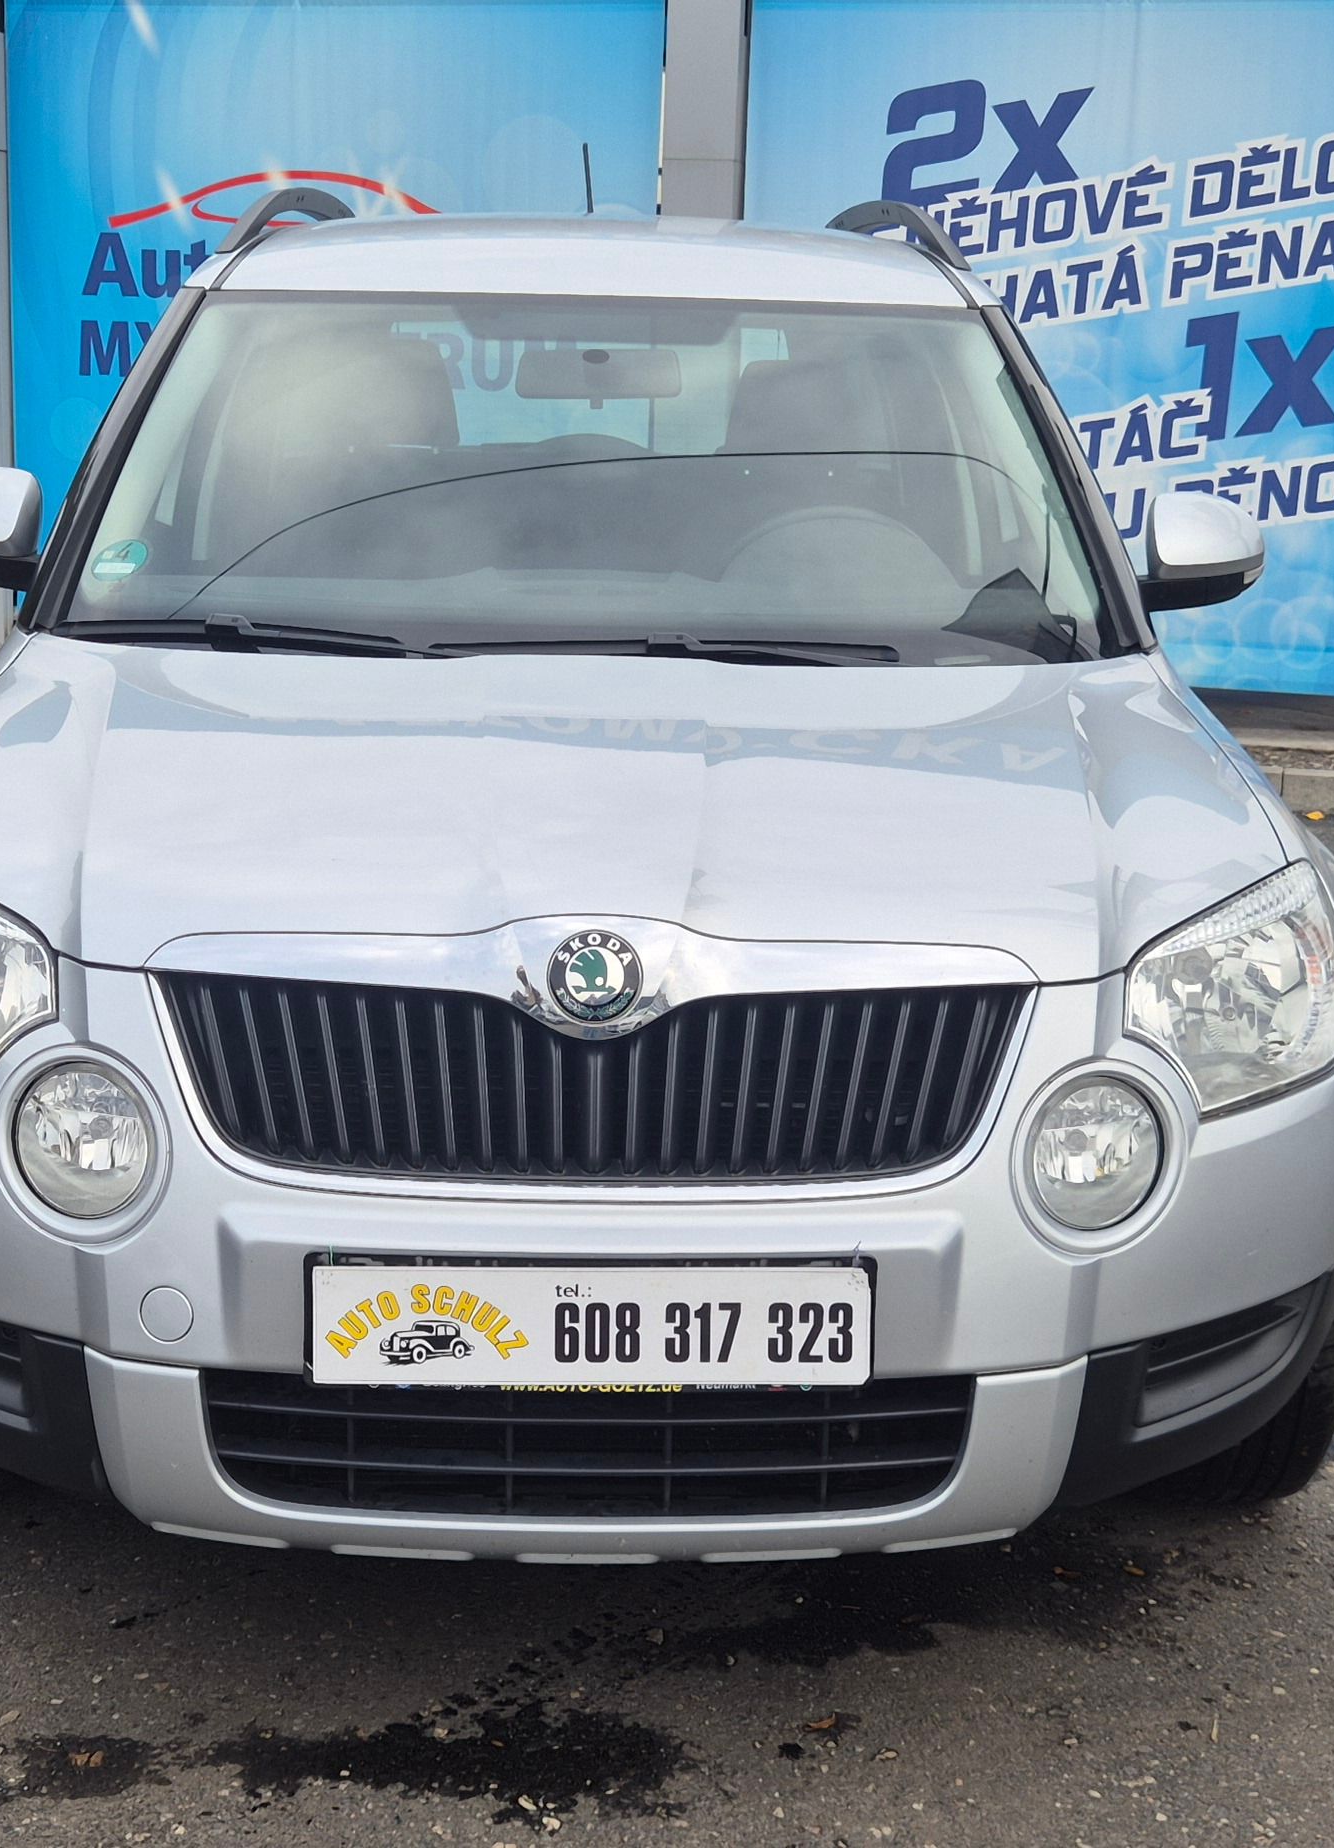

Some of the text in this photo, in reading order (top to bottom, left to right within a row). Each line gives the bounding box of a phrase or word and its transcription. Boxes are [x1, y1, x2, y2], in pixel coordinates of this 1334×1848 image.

[881, 79, 1095, 205] 2x
[325, 1283, 530, 1360] AUTO SCHULZ
[555, 1283, 593, 1298] tel.:
[554, 1302, 854, 1363] 608 317 323
